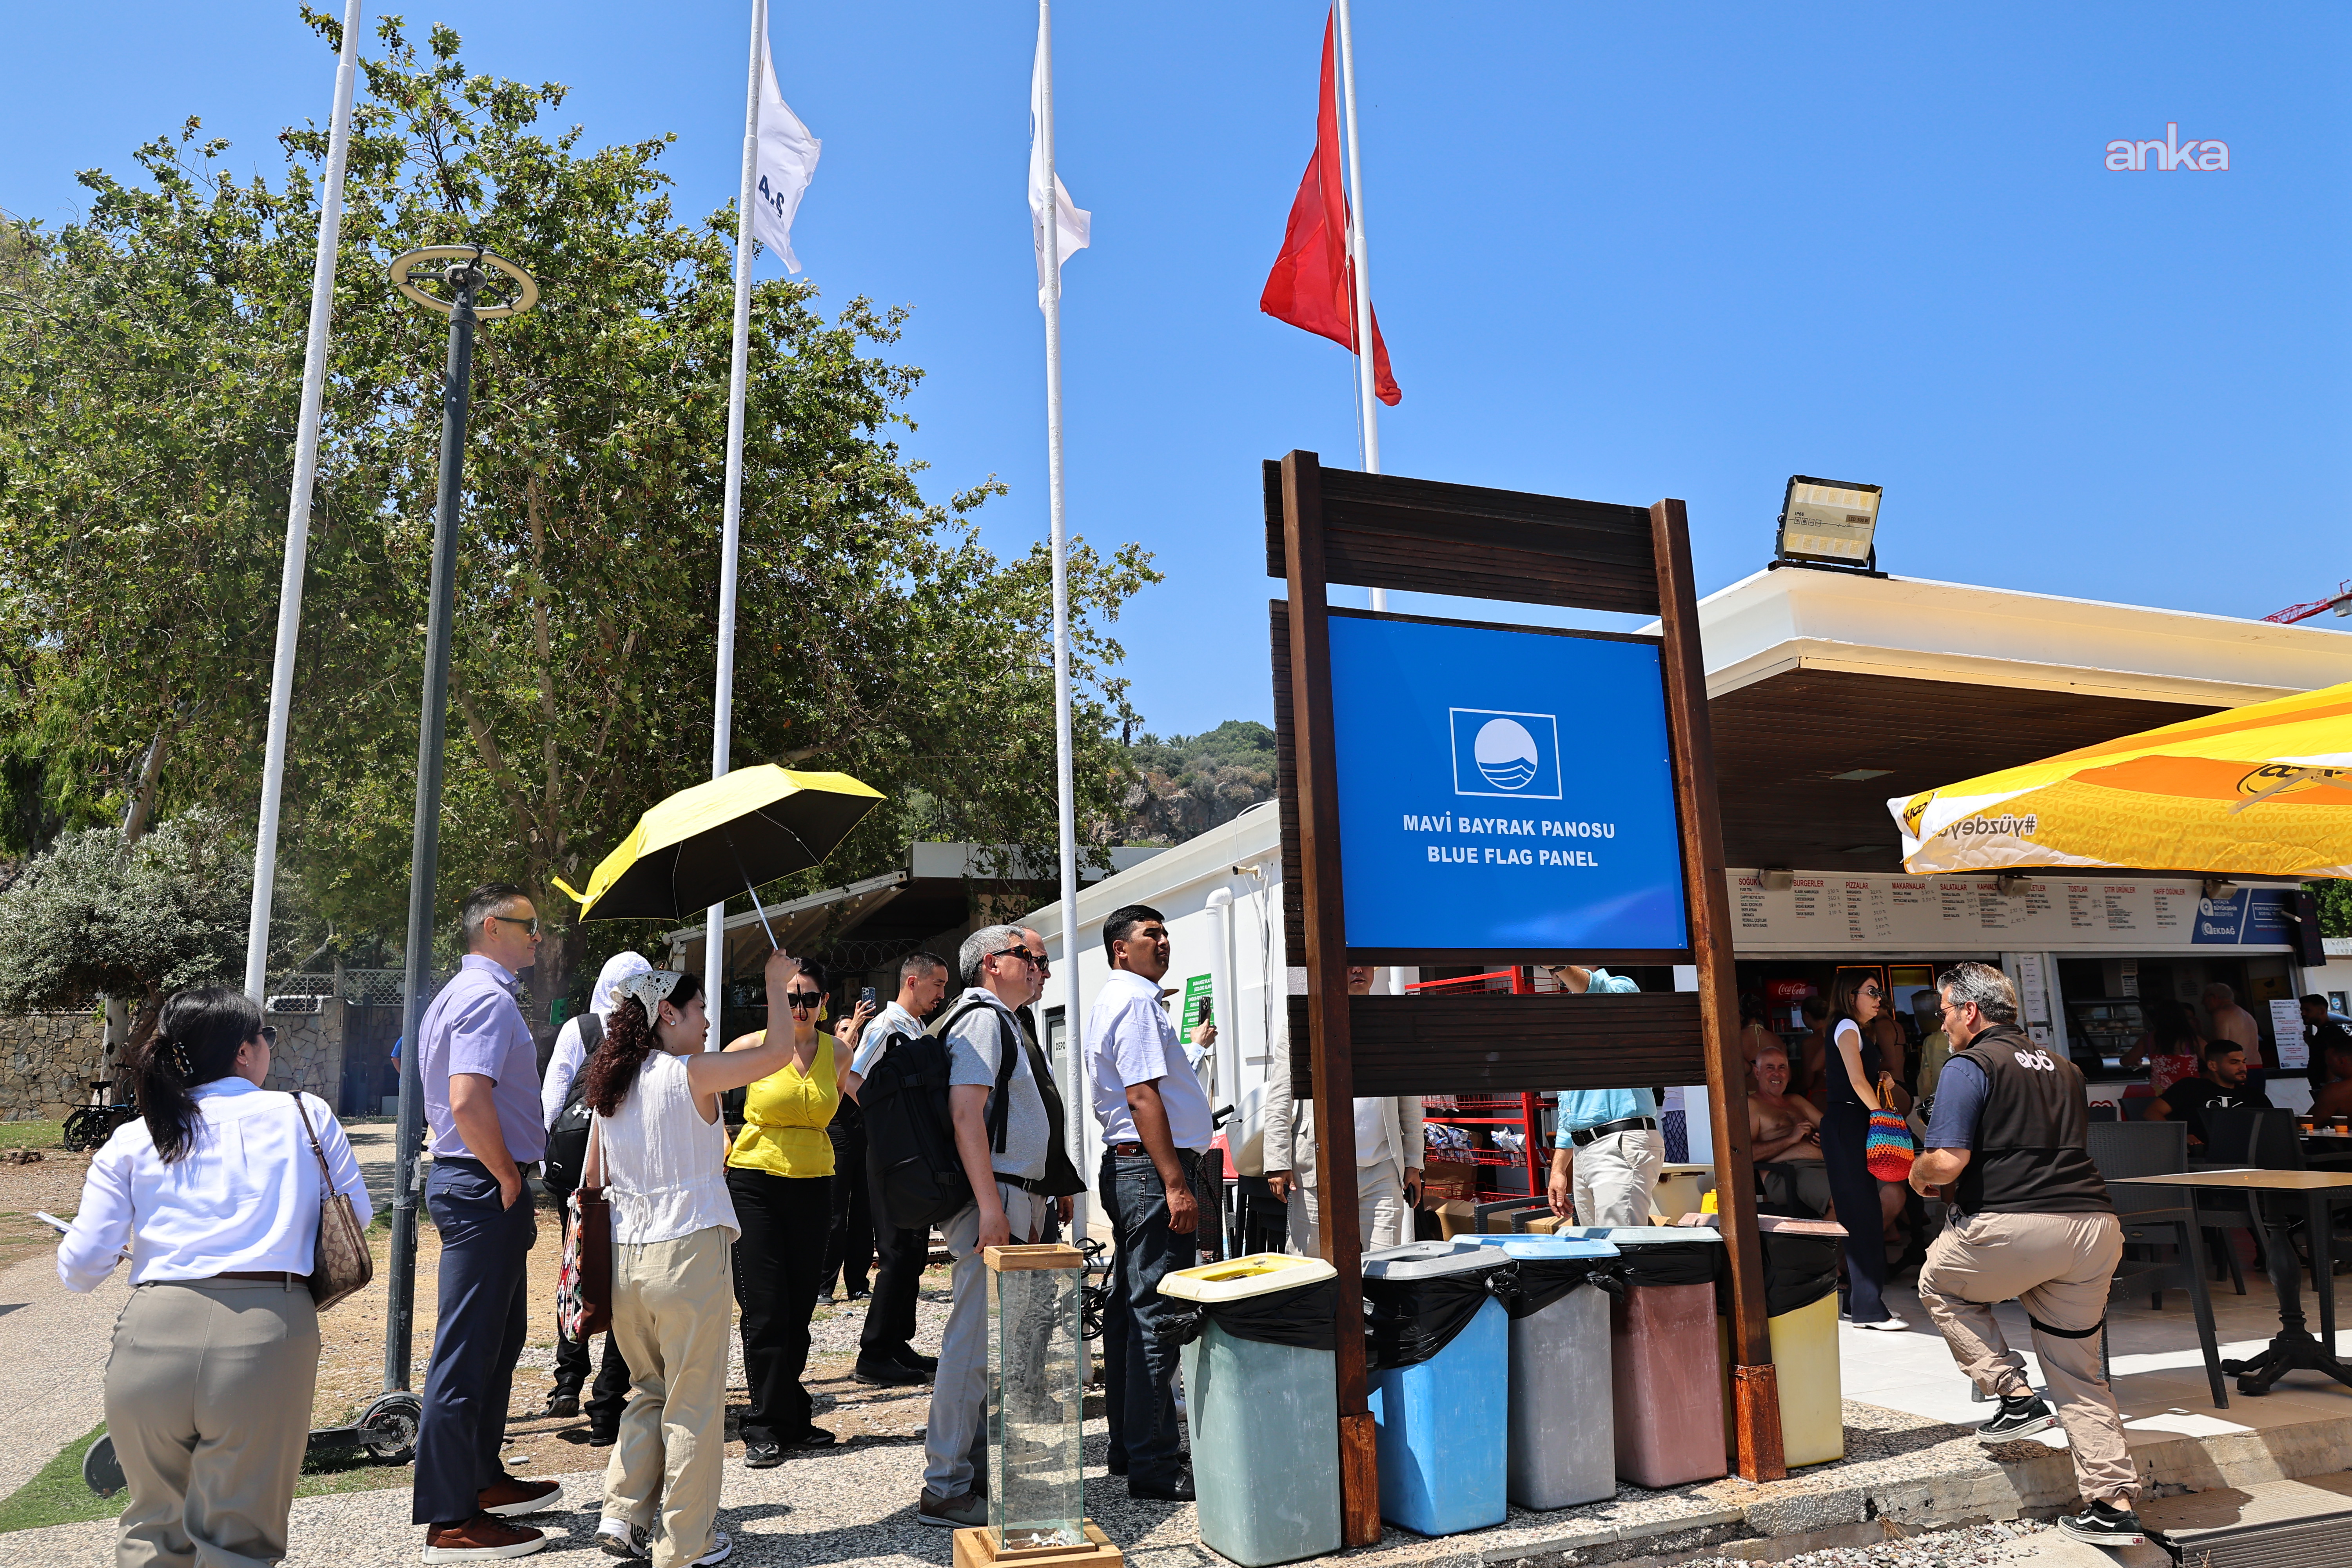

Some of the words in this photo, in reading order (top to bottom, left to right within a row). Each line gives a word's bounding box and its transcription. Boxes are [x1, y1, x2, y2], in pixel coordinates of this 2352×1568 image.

[1403, 811, 1452, 832] MAVİ
[1459, 817, 1536, 836] BAYRAK
[1542, 821, 1615, 838] PANOSU
[1428, 846, 1478, 864] BLUE
[1485, 848, 1533, 865] FLAG
[1539, 850, 1598, 867] PANEL
[1739, 877, 1758, 886] SOĞUK
[1846, 880, 1869, 889] PİZZALAR
[2213, 926, 2235, 935] EKDAĞ
[1056, 1041, 1065, 1051] DEPO
